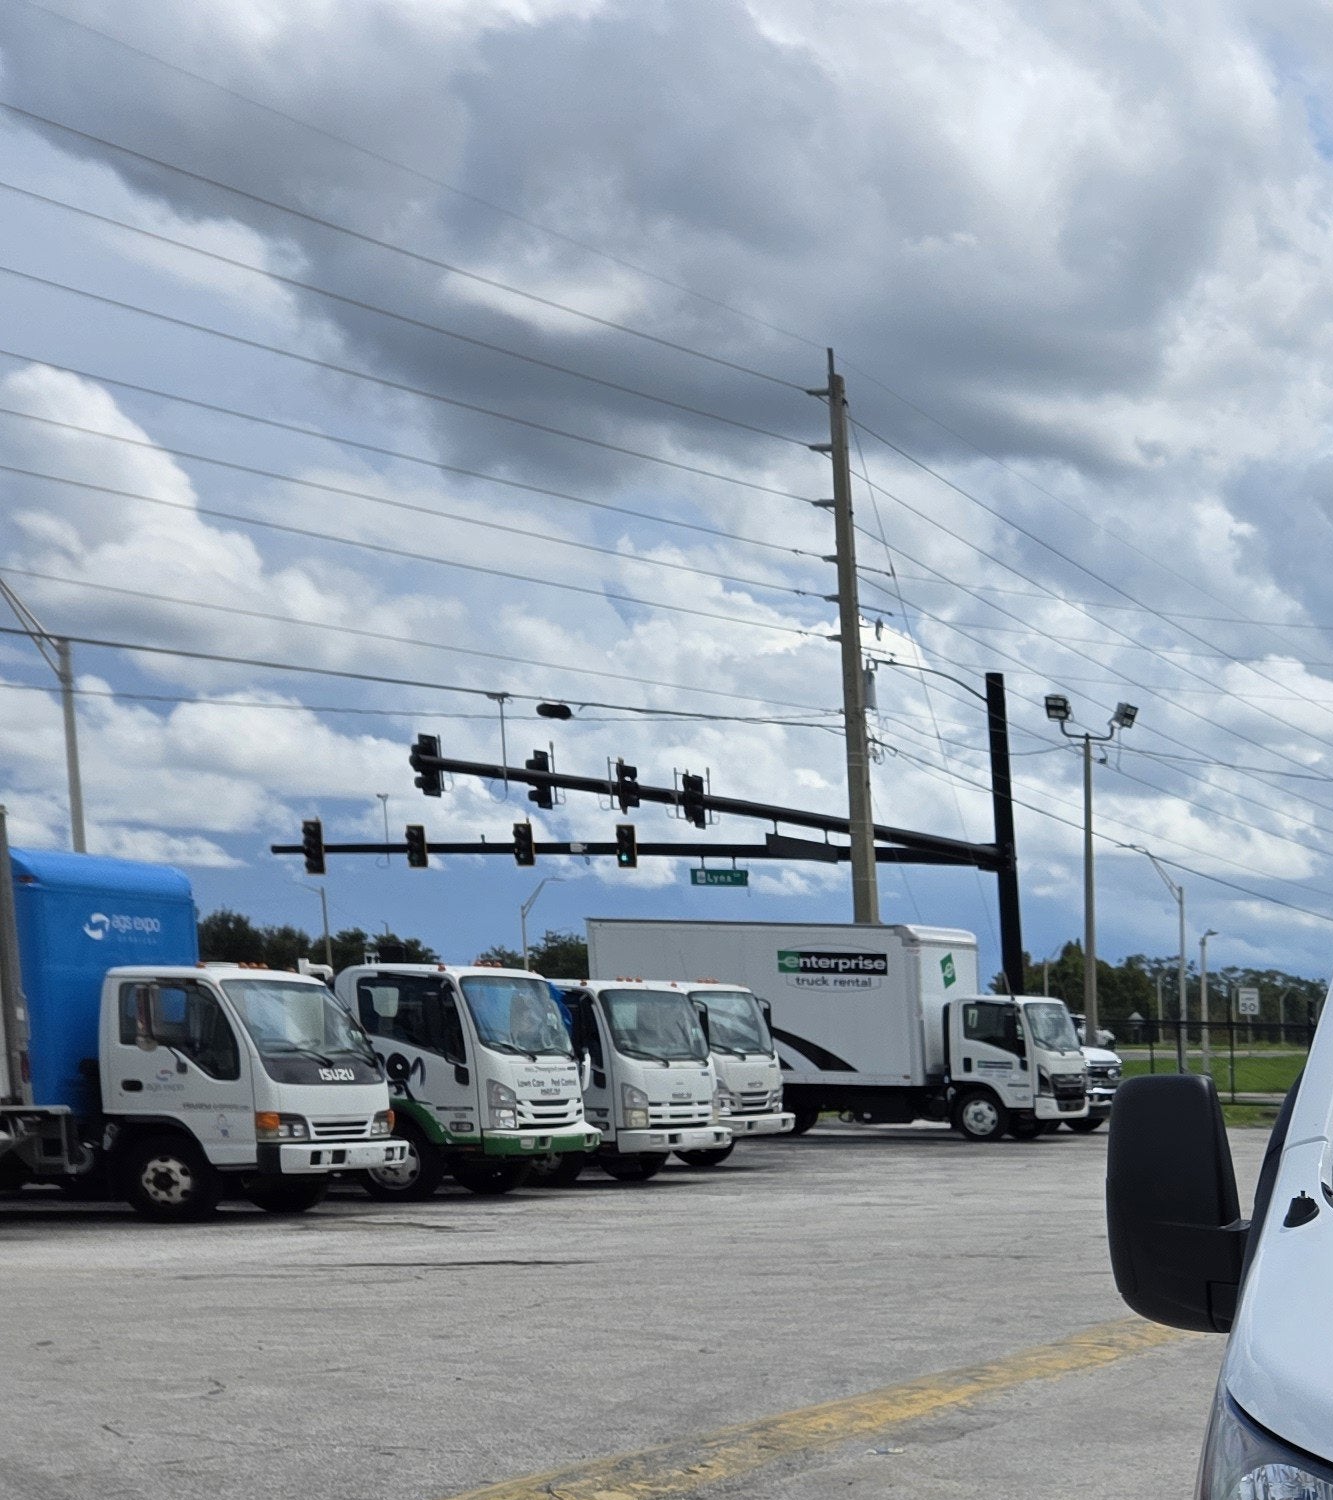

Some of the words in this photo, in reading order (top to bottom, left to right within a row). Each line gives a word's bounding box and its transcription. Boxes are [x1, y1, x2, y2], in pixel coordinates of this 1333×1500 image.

[778, 955, 886, 971] enterprise
[795, 977, 828, 986] truck
[833, 979, 871, 988] rental
[1241, 1003, 1256, 1011] 50
[318, 1068, 355, 1081] ISUZU
